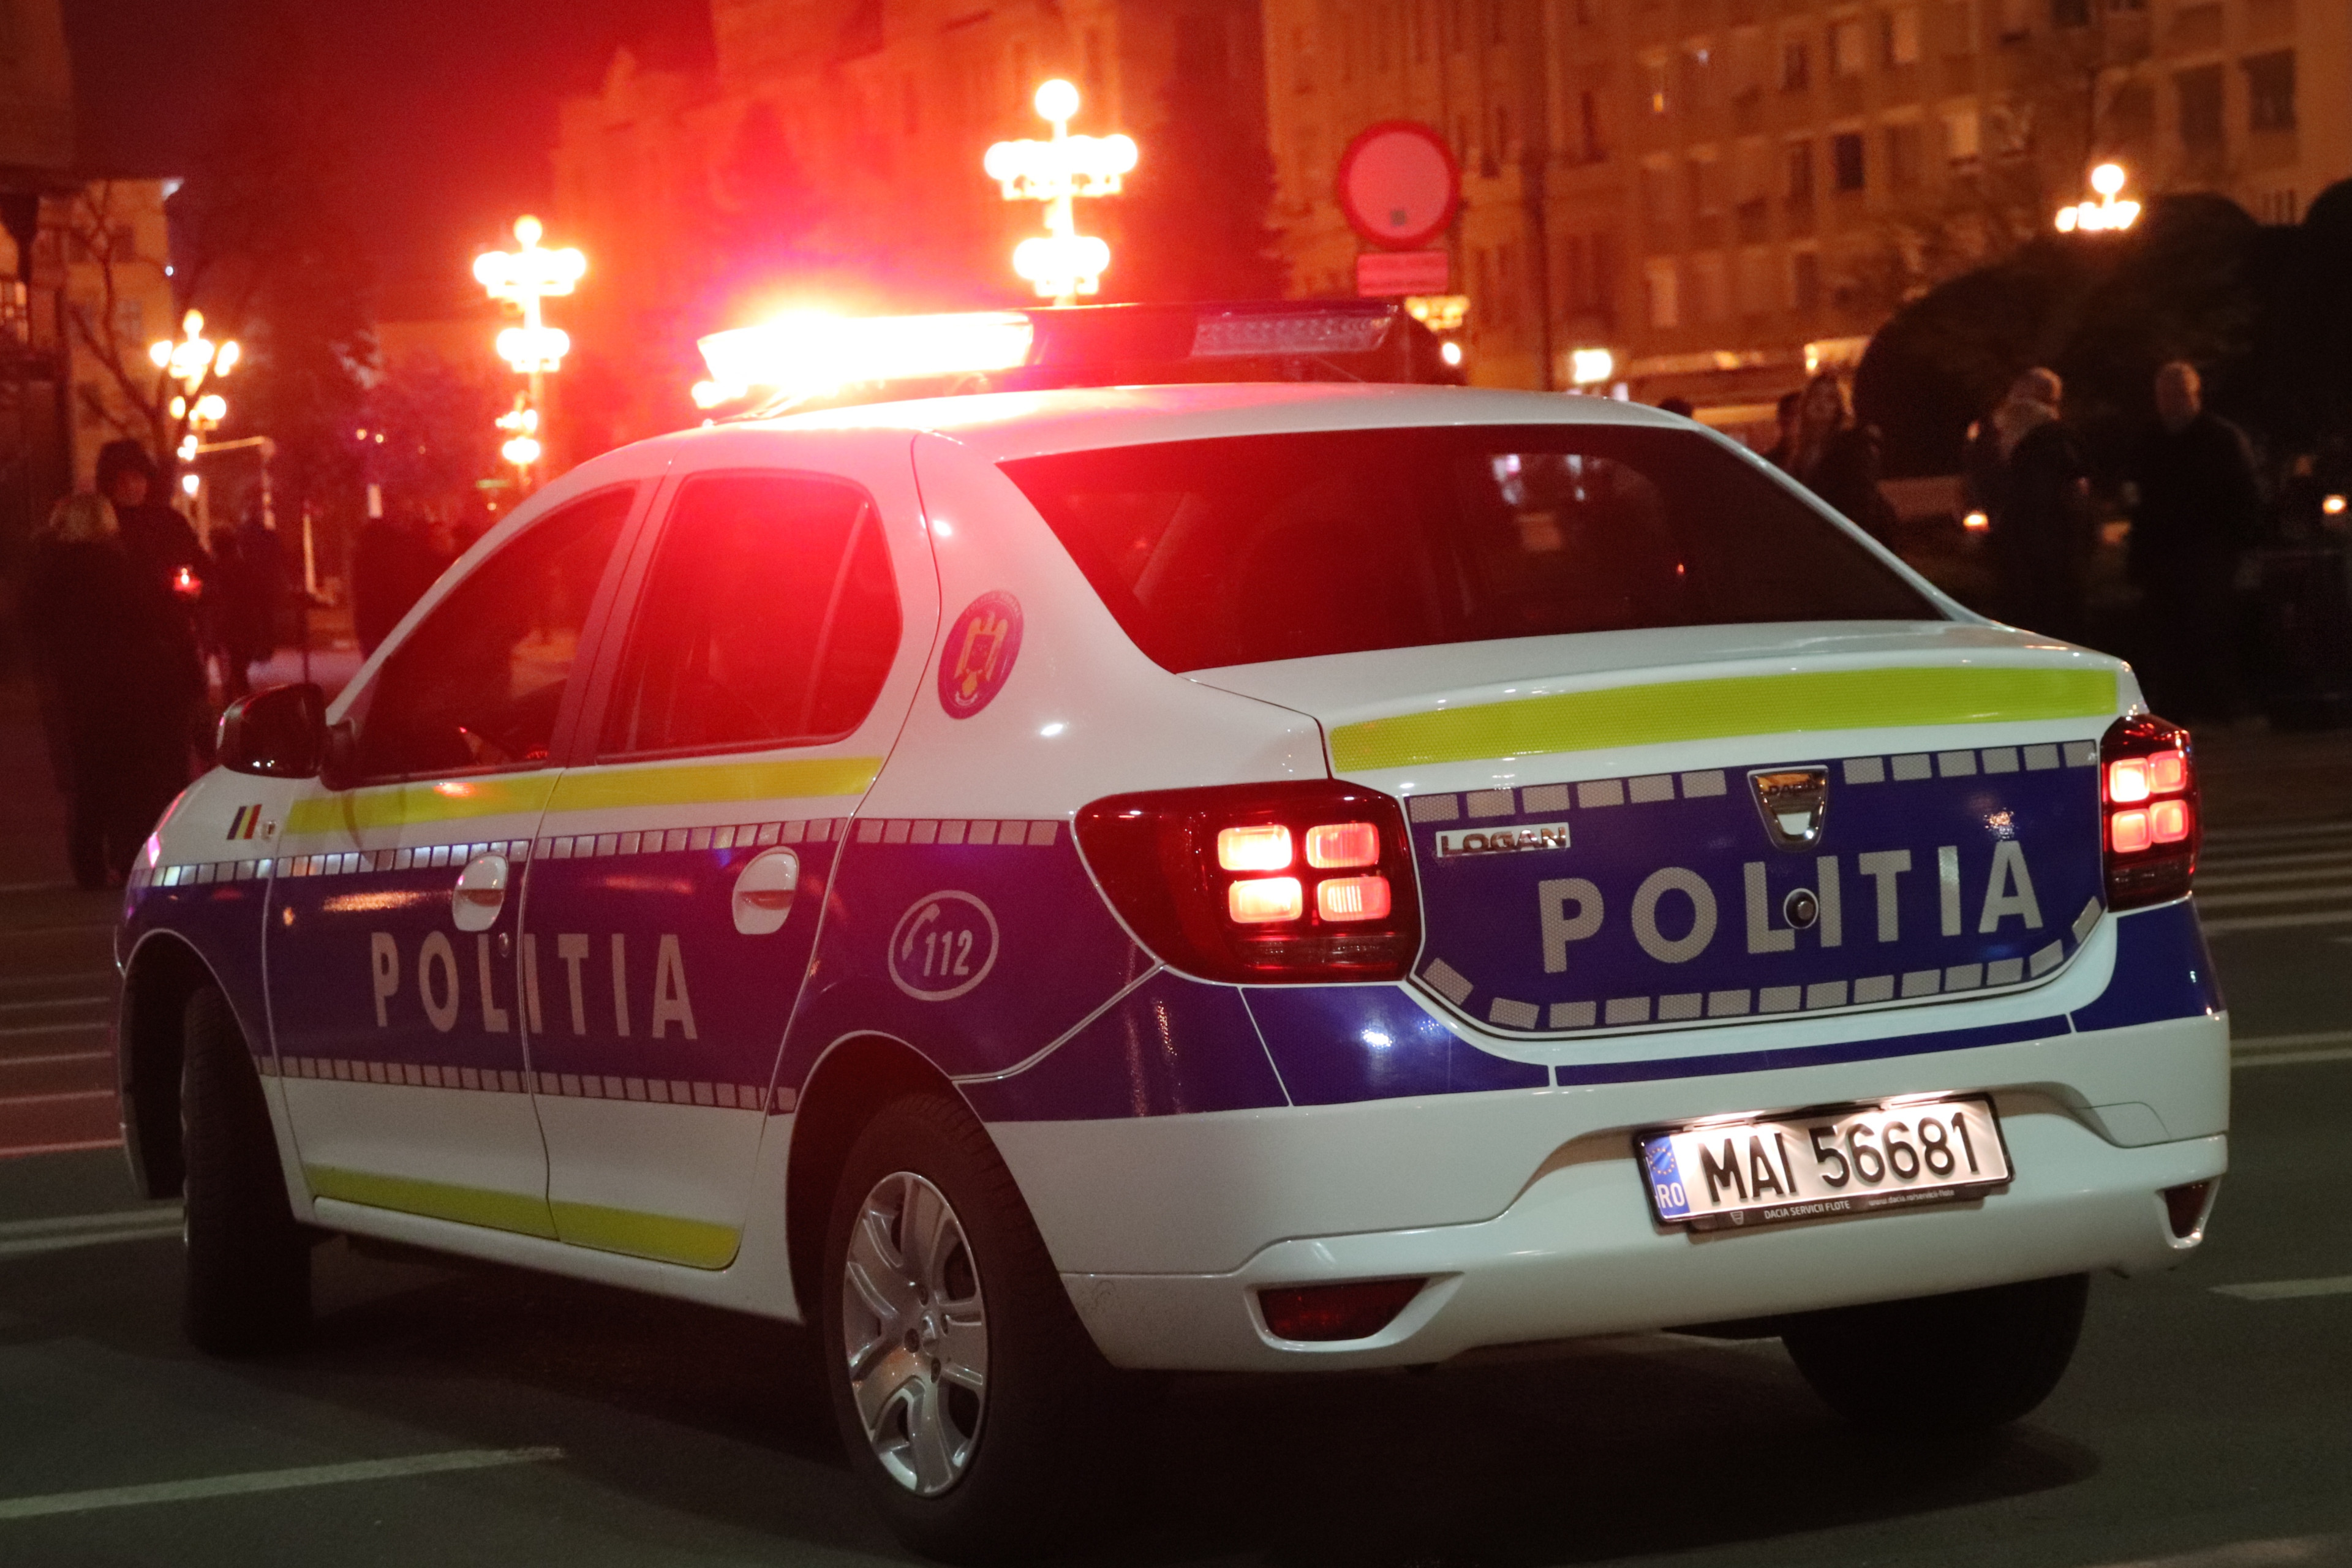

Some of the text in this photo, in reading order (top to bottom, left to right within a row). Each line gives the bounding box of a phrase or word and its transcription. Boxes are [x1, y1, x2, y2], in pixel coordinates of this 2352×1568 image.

[1440, 826, 1567, 856] LOGAN
[1539, 840, 2043, 974] POLITIA
[924, 929, 973, 976] 112
[371, 930, 698, 1040] POLITIA
[1697, 1111, 1979, 1203] MAI 56681
[1656, 1182, 1685, 1209] RO
[1763, 1199, 1851, 1219] DACIA SERVICII FLOTE
